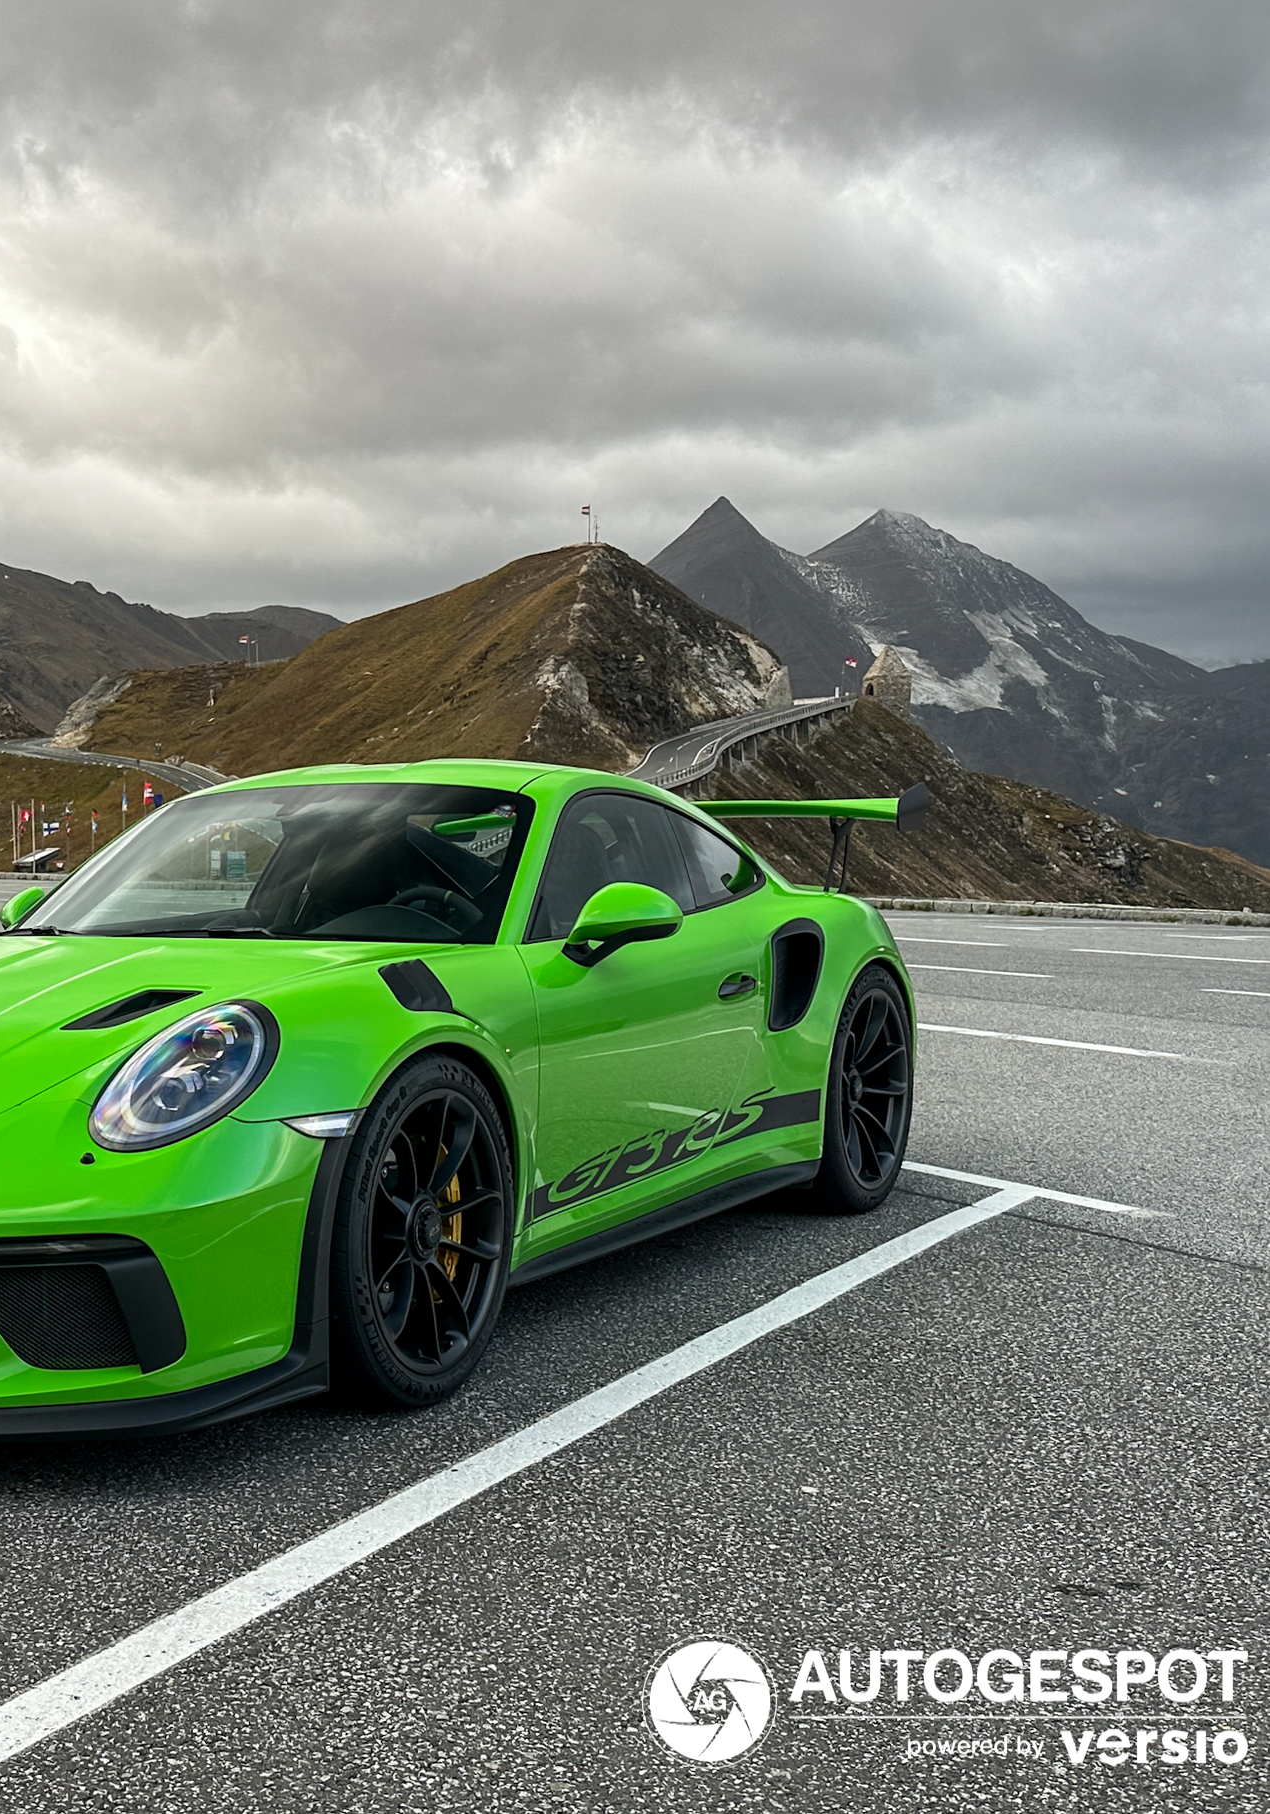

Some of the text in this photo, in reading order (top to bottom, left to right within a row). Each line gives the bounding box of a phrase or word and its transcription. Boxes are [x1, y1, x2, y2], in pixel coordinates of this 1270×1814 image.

[548, 1086, 776, 1203] GT3 RS
[365, 1319, 411, 1391] MICHELIN
